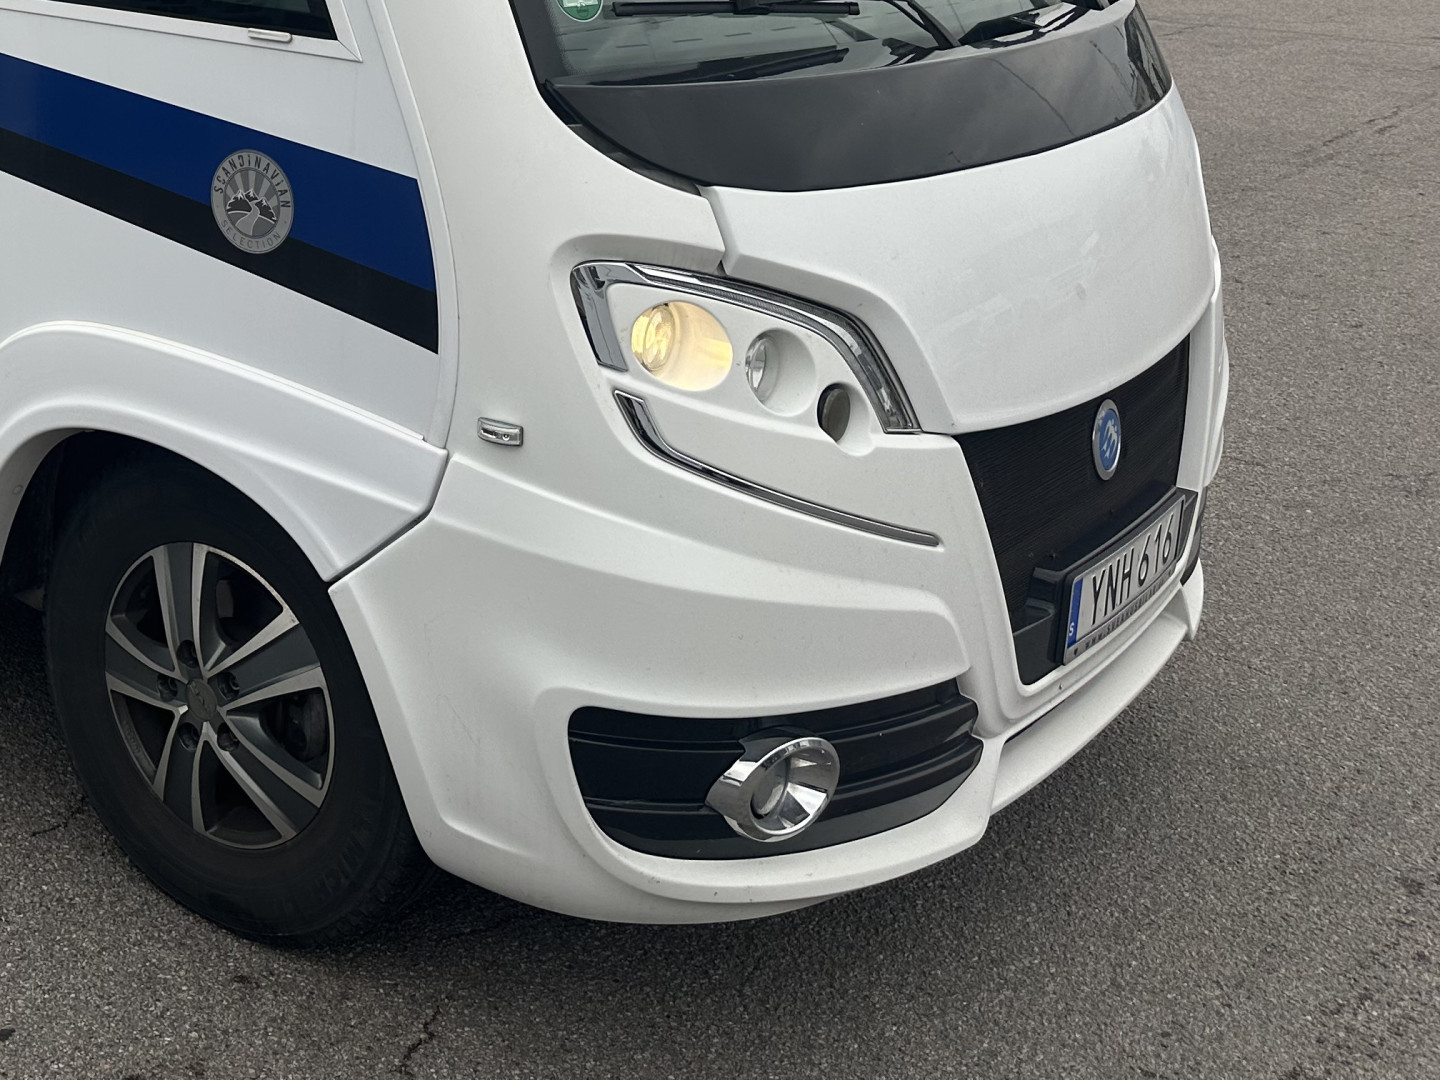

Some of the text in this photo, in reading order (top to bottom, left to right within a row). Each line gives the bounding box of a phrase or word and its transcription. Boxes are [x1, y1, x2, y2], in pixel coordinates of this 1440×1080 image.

[213, 154, 291, 208] SCANDINAVIAN
[221, 219, 281, 249] SELECTION
[1091, 512, 1174, 625] YNH 616
[1068, 622, 1075, 637] S
